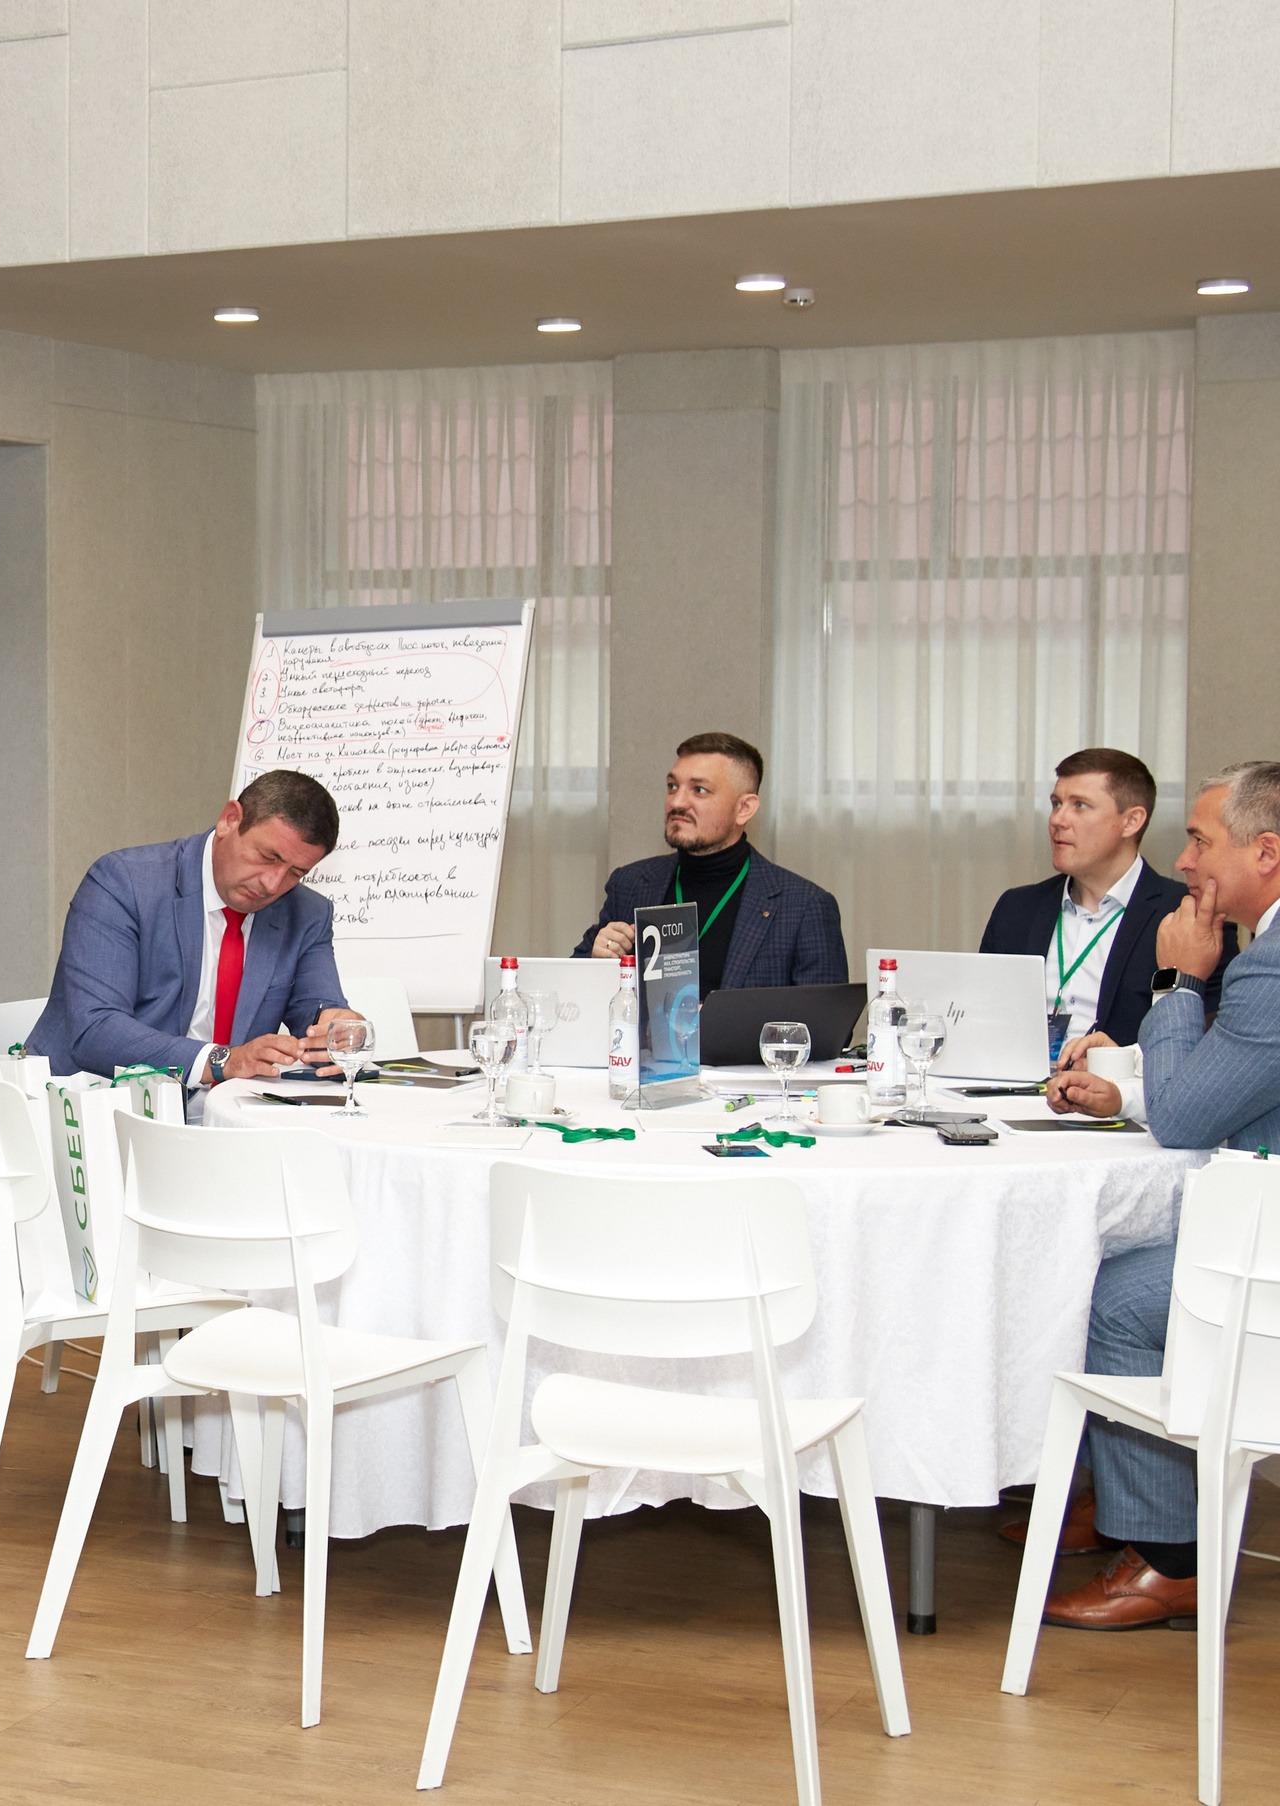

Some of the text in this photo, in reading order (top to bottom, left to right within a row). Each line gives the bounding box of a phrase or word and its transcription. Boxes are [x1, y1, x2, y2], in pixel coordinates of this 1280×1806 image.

[276, 746, 303, 761] Мост
[446, 865, 458, 881] в
[661, 922, 684, 937] СТОЛ
[642, 925, 663, 982] 2
[63, 1097, 88, 1231] СБЕР
